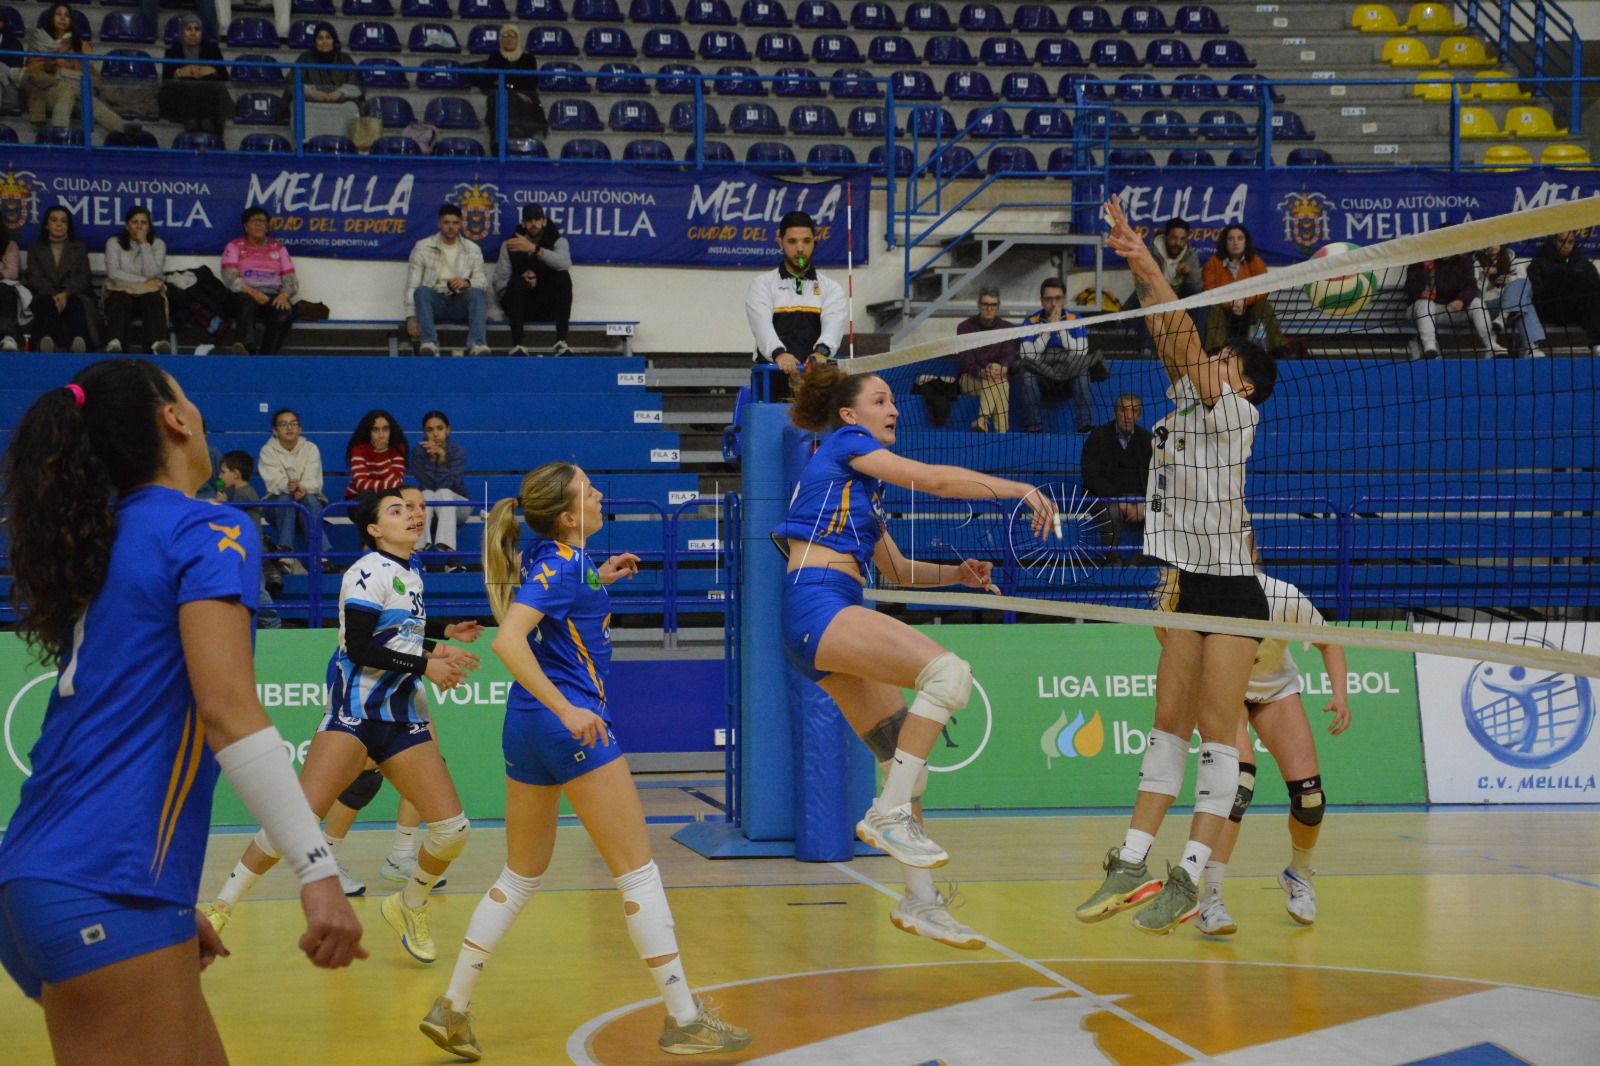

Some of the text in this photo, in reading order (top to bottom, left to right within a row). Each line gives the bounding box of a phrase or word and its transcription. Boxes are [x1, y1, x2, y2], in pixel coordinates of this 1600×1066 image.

[53, 177, 211, 195] CIUDAD AUTÓNOMA
[245, 170, 415, 216] MELILLA
[513, 187, 656, 206] CIUDAD AUTÓNOMA
[1340, 192, 1480, 210] CIUDAD AUTÓNOMA
[57, 194, 213, 228] MELLLA
[309, 217, 336, 232] DEL
[344, 218, 406, 234] DEPORTE
[517, 206, 656, 238] ELILLA
[687, 225, 738, 241] CIUDAD
[741, 226, 769, 242] DEL
[625, 326, 632, 334] 6
[637, 375, 644, 384] 5
[653, 413, 660, 422] 4
[671, 452, 678, 460] 3
[1037, 675, 1100, 698] LIGA
[1477, 776, 1513, 789] C.V.
